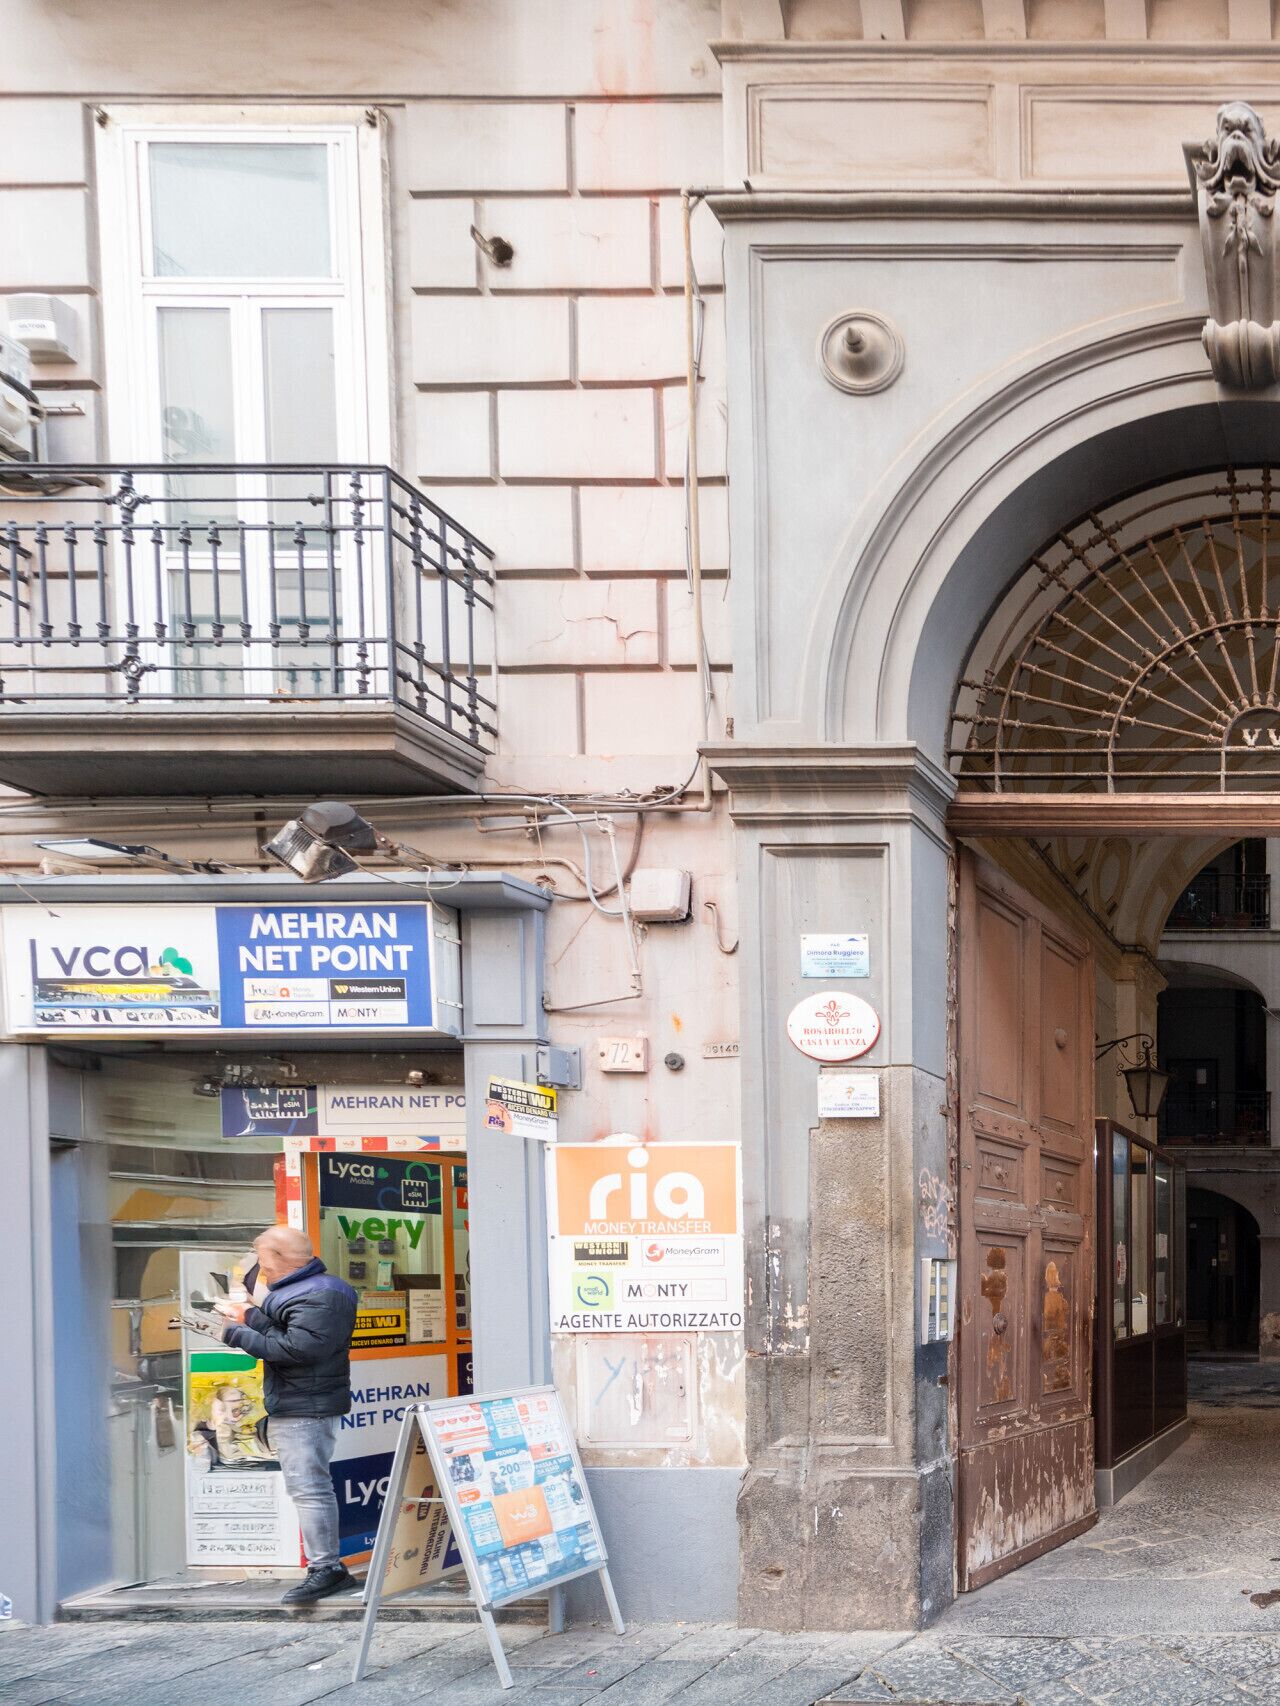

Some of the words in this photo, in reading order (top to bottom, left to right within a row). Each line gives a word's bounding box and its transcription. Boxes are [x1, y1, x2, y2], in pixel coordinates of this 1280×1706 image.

[250, 912, 398, 939] MEHRAN
[239, 945, 302, 972] NET
[310, 945, 414, 972] POINT
[610, 1043, 630, 1064] 72
[330, 1096, 402, 1109] MEHRAN
[409, 1096, 441, 1109] NET
[445, 1095, 467, 1108] PO
[501, 1091, 528, 1105] UNION
[328, 1158, 375, 1178] Lyca
[350, 1177, 375, 1186] Mobile
[588, 1146, 705, 1220] ria
[337, 1215, 425, 1250] very
[584, 1221, 637, 1235] MONEY
[638, 1220, 712, 1235] TRANSFER
[575, 1242, 620, 1250] WESTERN
[589, 1248, 620, 1256] UNION
[665, 1247, 720, 1257] MoneyGram
[559, 1313, 623, 1329] AGENTE
[626, 1312, 742, 1329] AUTORIZZATO
[351, 1339, 370, 1347] RICEVI
[349, 1382, 431, 1405] MEHRAN
[340, 1411, 378, 1430] NET
[499, 1461, 521, 1477] 200
[344, 1475, 391, 1507] Lyc
[432, 1529, 446, 1560] ONLINE
